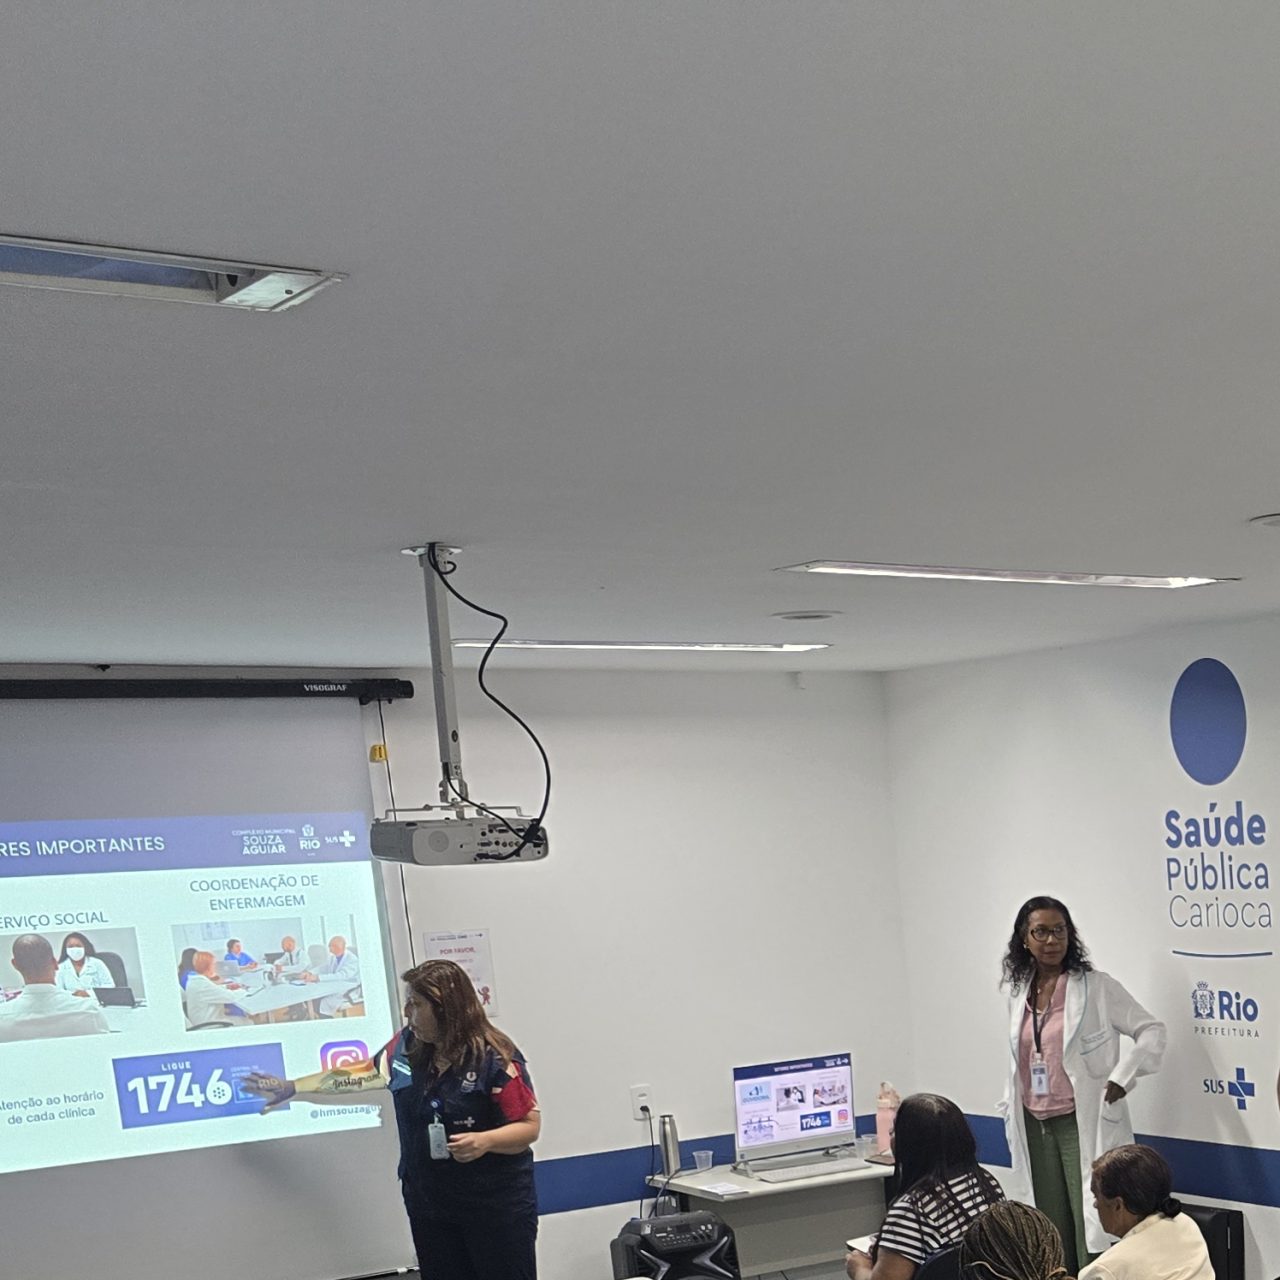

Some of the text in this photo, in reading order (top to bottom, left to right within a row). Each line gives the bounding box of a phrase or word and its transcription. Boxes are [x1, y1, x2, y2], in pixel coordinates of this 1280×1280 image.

[303, 684, 347, 692] VISOGRAF
[1165, 800, 1266, 849] Saúde
[0, 836, 165, 857] RES IMPORTANTES
[242, 835, 283, 846] SOUZA
[300, 840, 320, 850] RIO
[242, 844, 286, 855] AGUIAR
[1166, 851, 1269, 891] Pública
[189, 874, 319, 892] COORDENAÇÃO DE
[209, 895, 306, 911] ENFERMAGEM
[1169, 894, 1272, 928] Carioca
[54, 911, 109, 926] SOCIAL
[1218, 990, 1259, 1022] Rio
[1194, 1026, 1260, 1038] PREFEITURA
[161, 1061, 192, 1072] LIGUE
[332, 1073, 381, 1090] Instagram
[1203, 1078, 1225, 1095] SUS
[127, 1068, 232, 1114] 1746
[0, 1090, 105, 1110] tenção ao horário
[8, 1106, 96, 1125] de cada clínica
[802, 1117, 822, 1129] 1746
